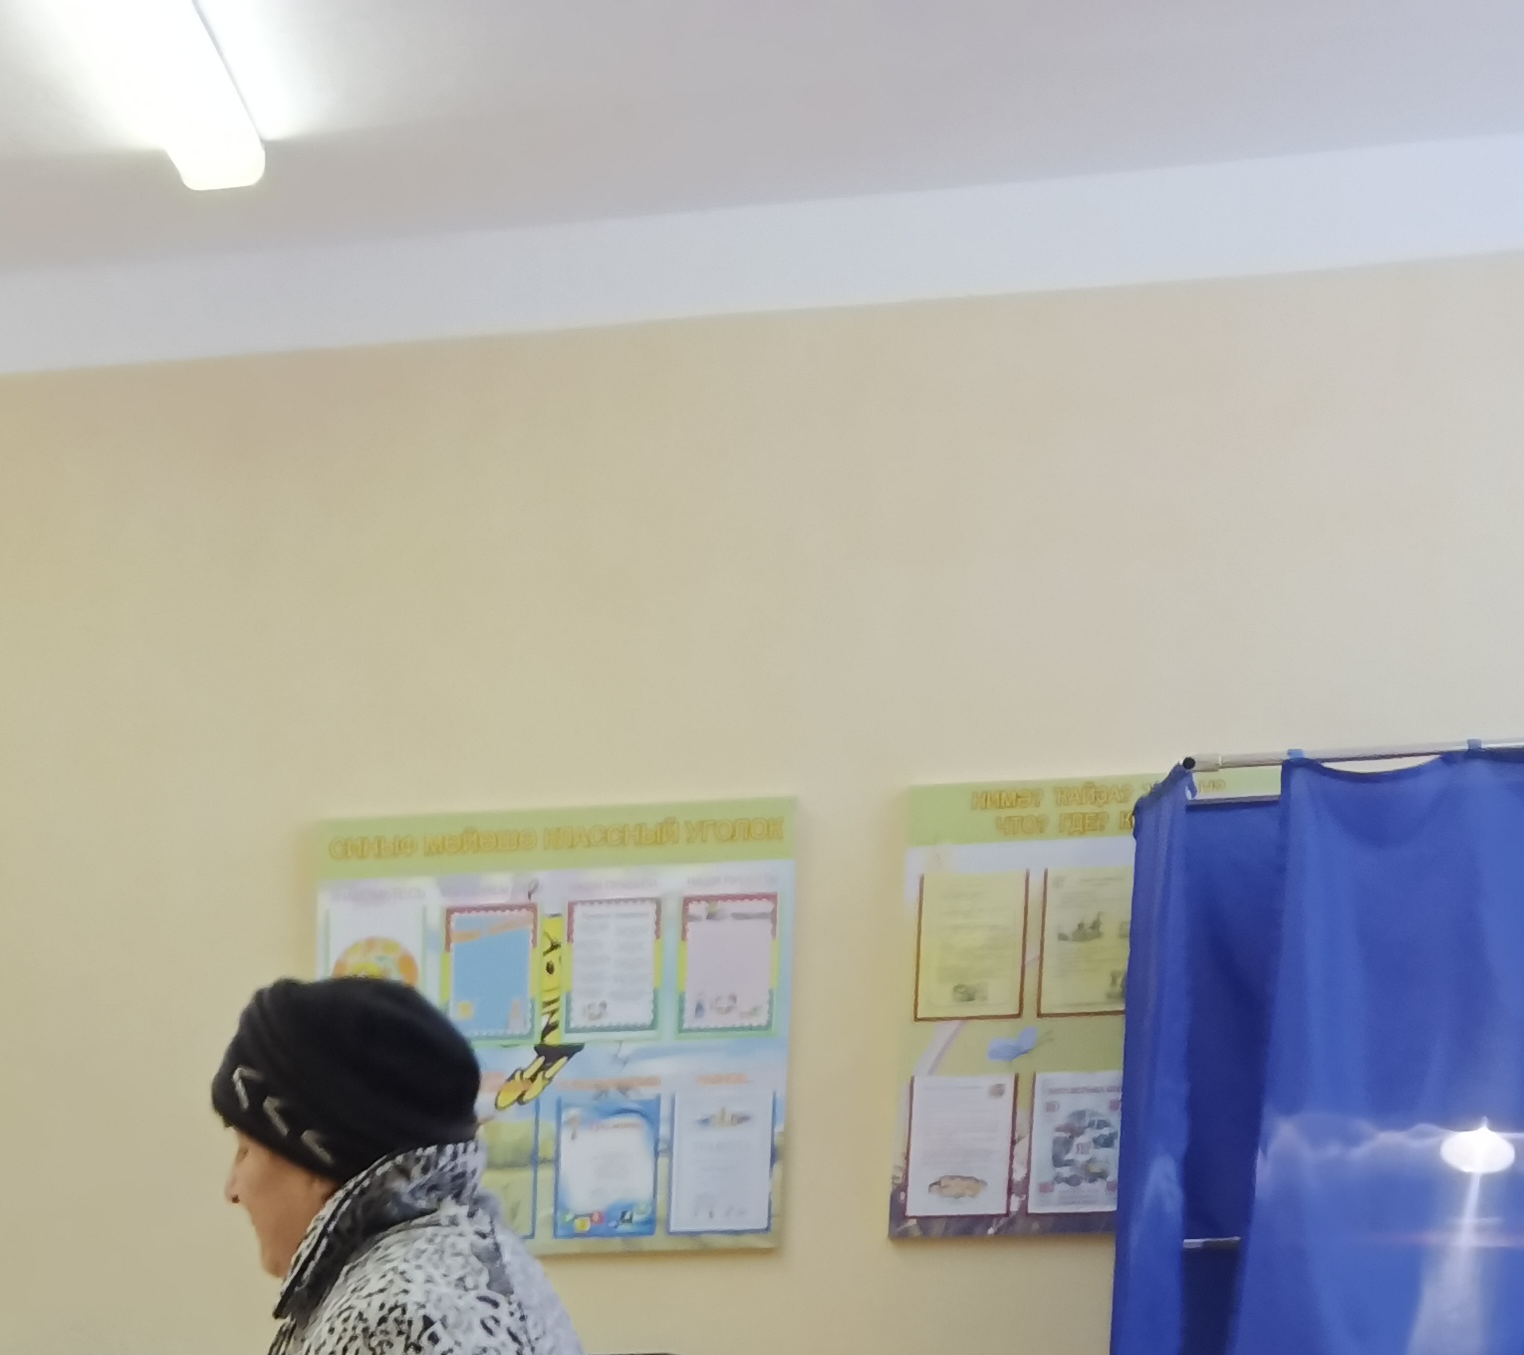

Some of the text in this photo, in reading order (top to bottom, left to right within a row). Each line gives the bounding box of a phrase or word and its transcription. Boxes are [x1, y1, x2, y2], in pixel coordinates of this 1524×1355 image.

[328, 816, 784, 861] СИНЫФ МӘЙӘШӘ КЛАССНЫЙ УГОЛОК
[995, 813, 1050, 836] ЧТО?
[1058, 811, 1110, 836] ГДЕ?
